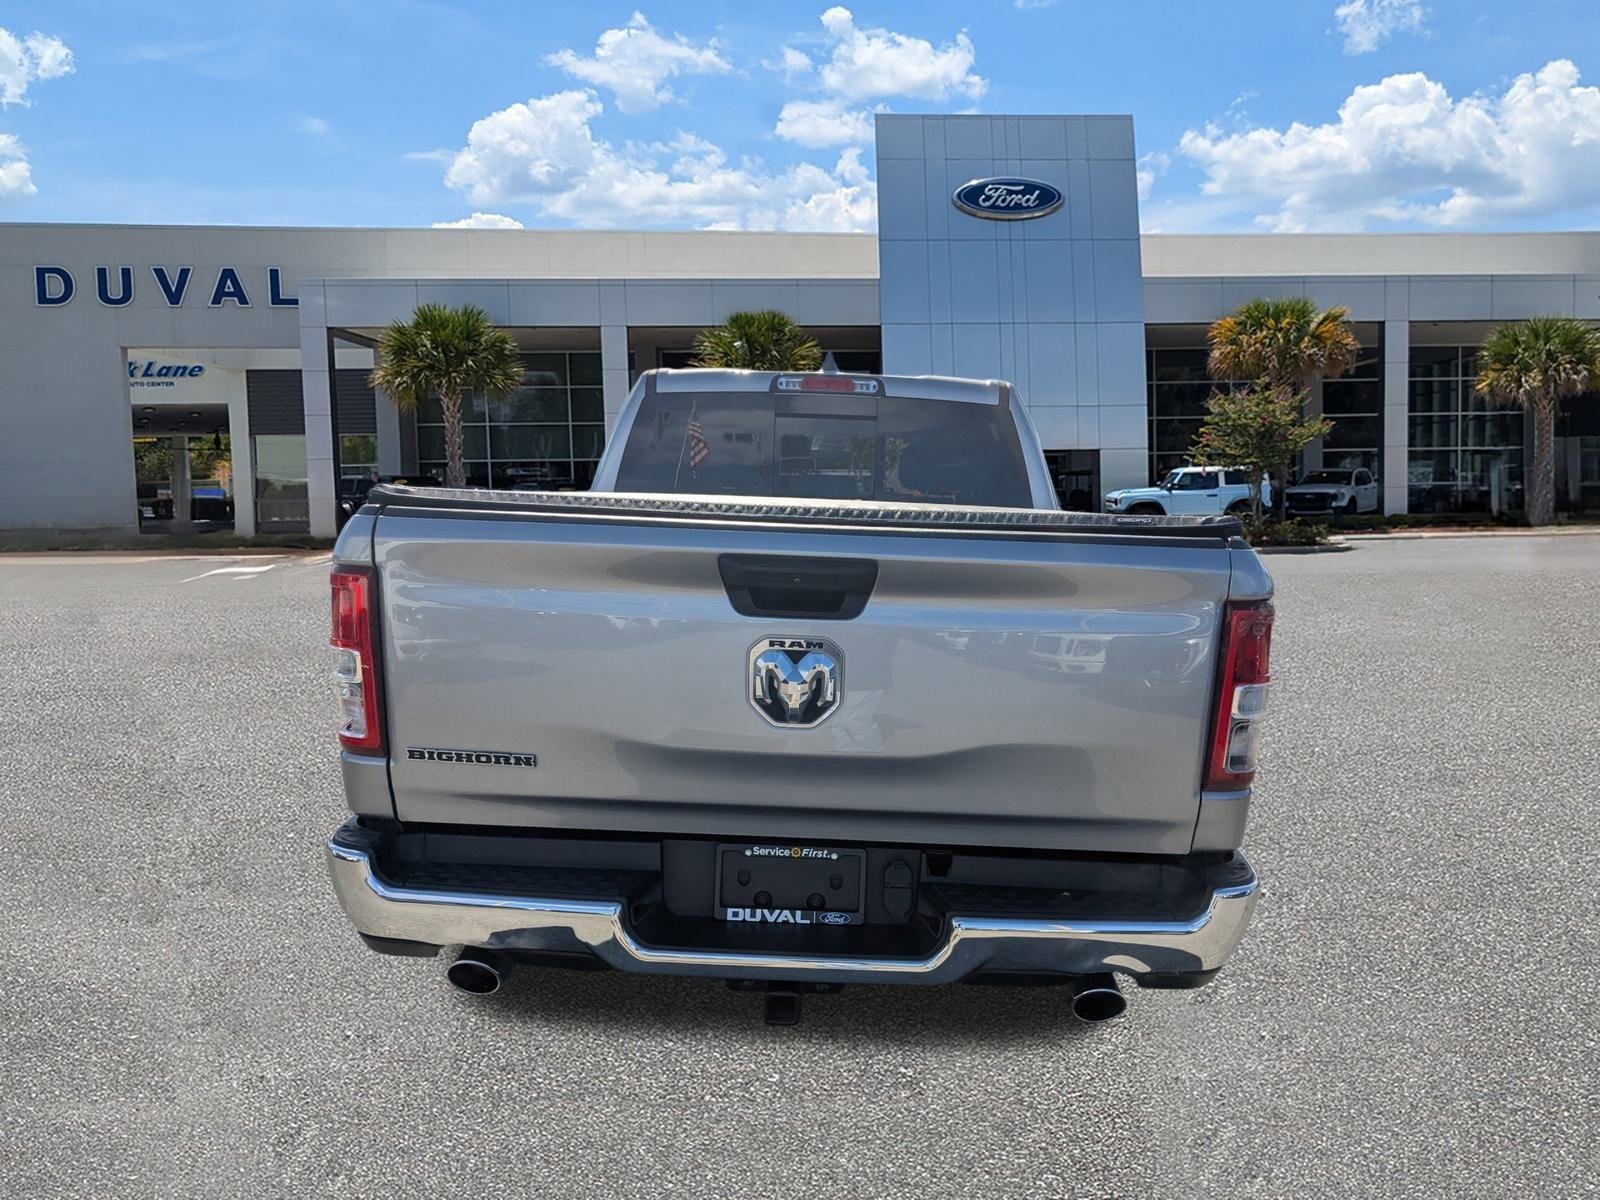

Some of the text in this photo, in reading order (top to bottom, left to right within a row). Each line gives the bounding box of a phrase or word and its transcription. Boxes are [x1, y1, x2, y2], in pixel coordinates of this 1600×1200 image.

[979, 184, 1041, 207] Ford
[33, 265, 299, 308] DUVAL
[142, 361, 205, 378] Lane
[768, 640, 824, 650] RAM
[406, 748, 537, 768] BIGHORN
[752, 846, 790, 857] Service
[726, 907, 811, 924] DUVAL
